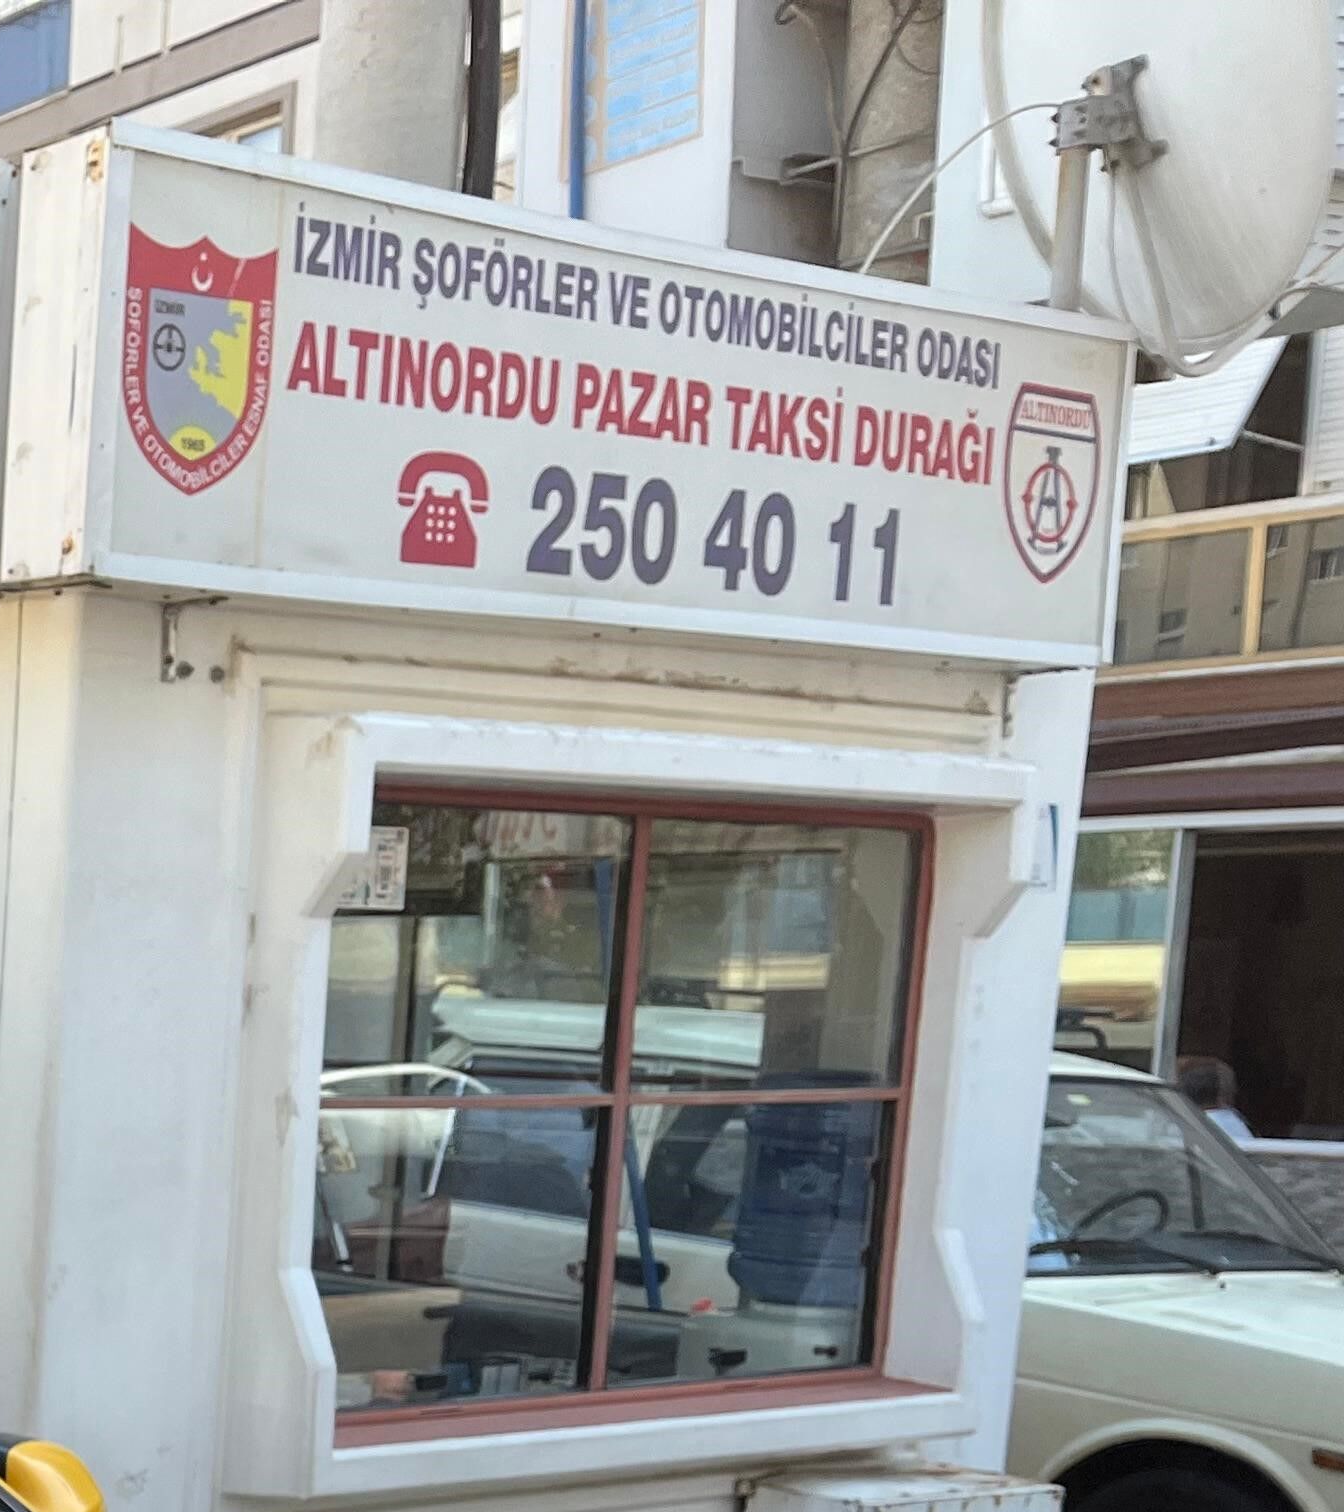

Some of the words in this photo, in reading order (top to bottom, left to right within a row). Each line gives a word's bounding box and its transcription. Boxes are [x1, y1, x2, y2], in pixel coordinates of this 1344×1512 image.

[294, 201, 403, 290] İZMİR
[413, 238, 599, 321] ŞOFÖRLER
[608, 271, 651, 329] VE
[659, 281, 909, 373] OTOMOBİLCİLER
[917, 328, 1001, 389] ODASI
[286, 321, 561, 426] ALTINORDU
[572, 363, 712, 447] PAZAR
[725, 386, 844, 463] TAKSİ
[854, 406, 995, 485] DURAĞI
[1020, 400, 1092, 431] ALTINORDU
[526, 465, 678, 586] 250
[703, 489, 796, 597] 40
[829, 502, 900, 606] 11
